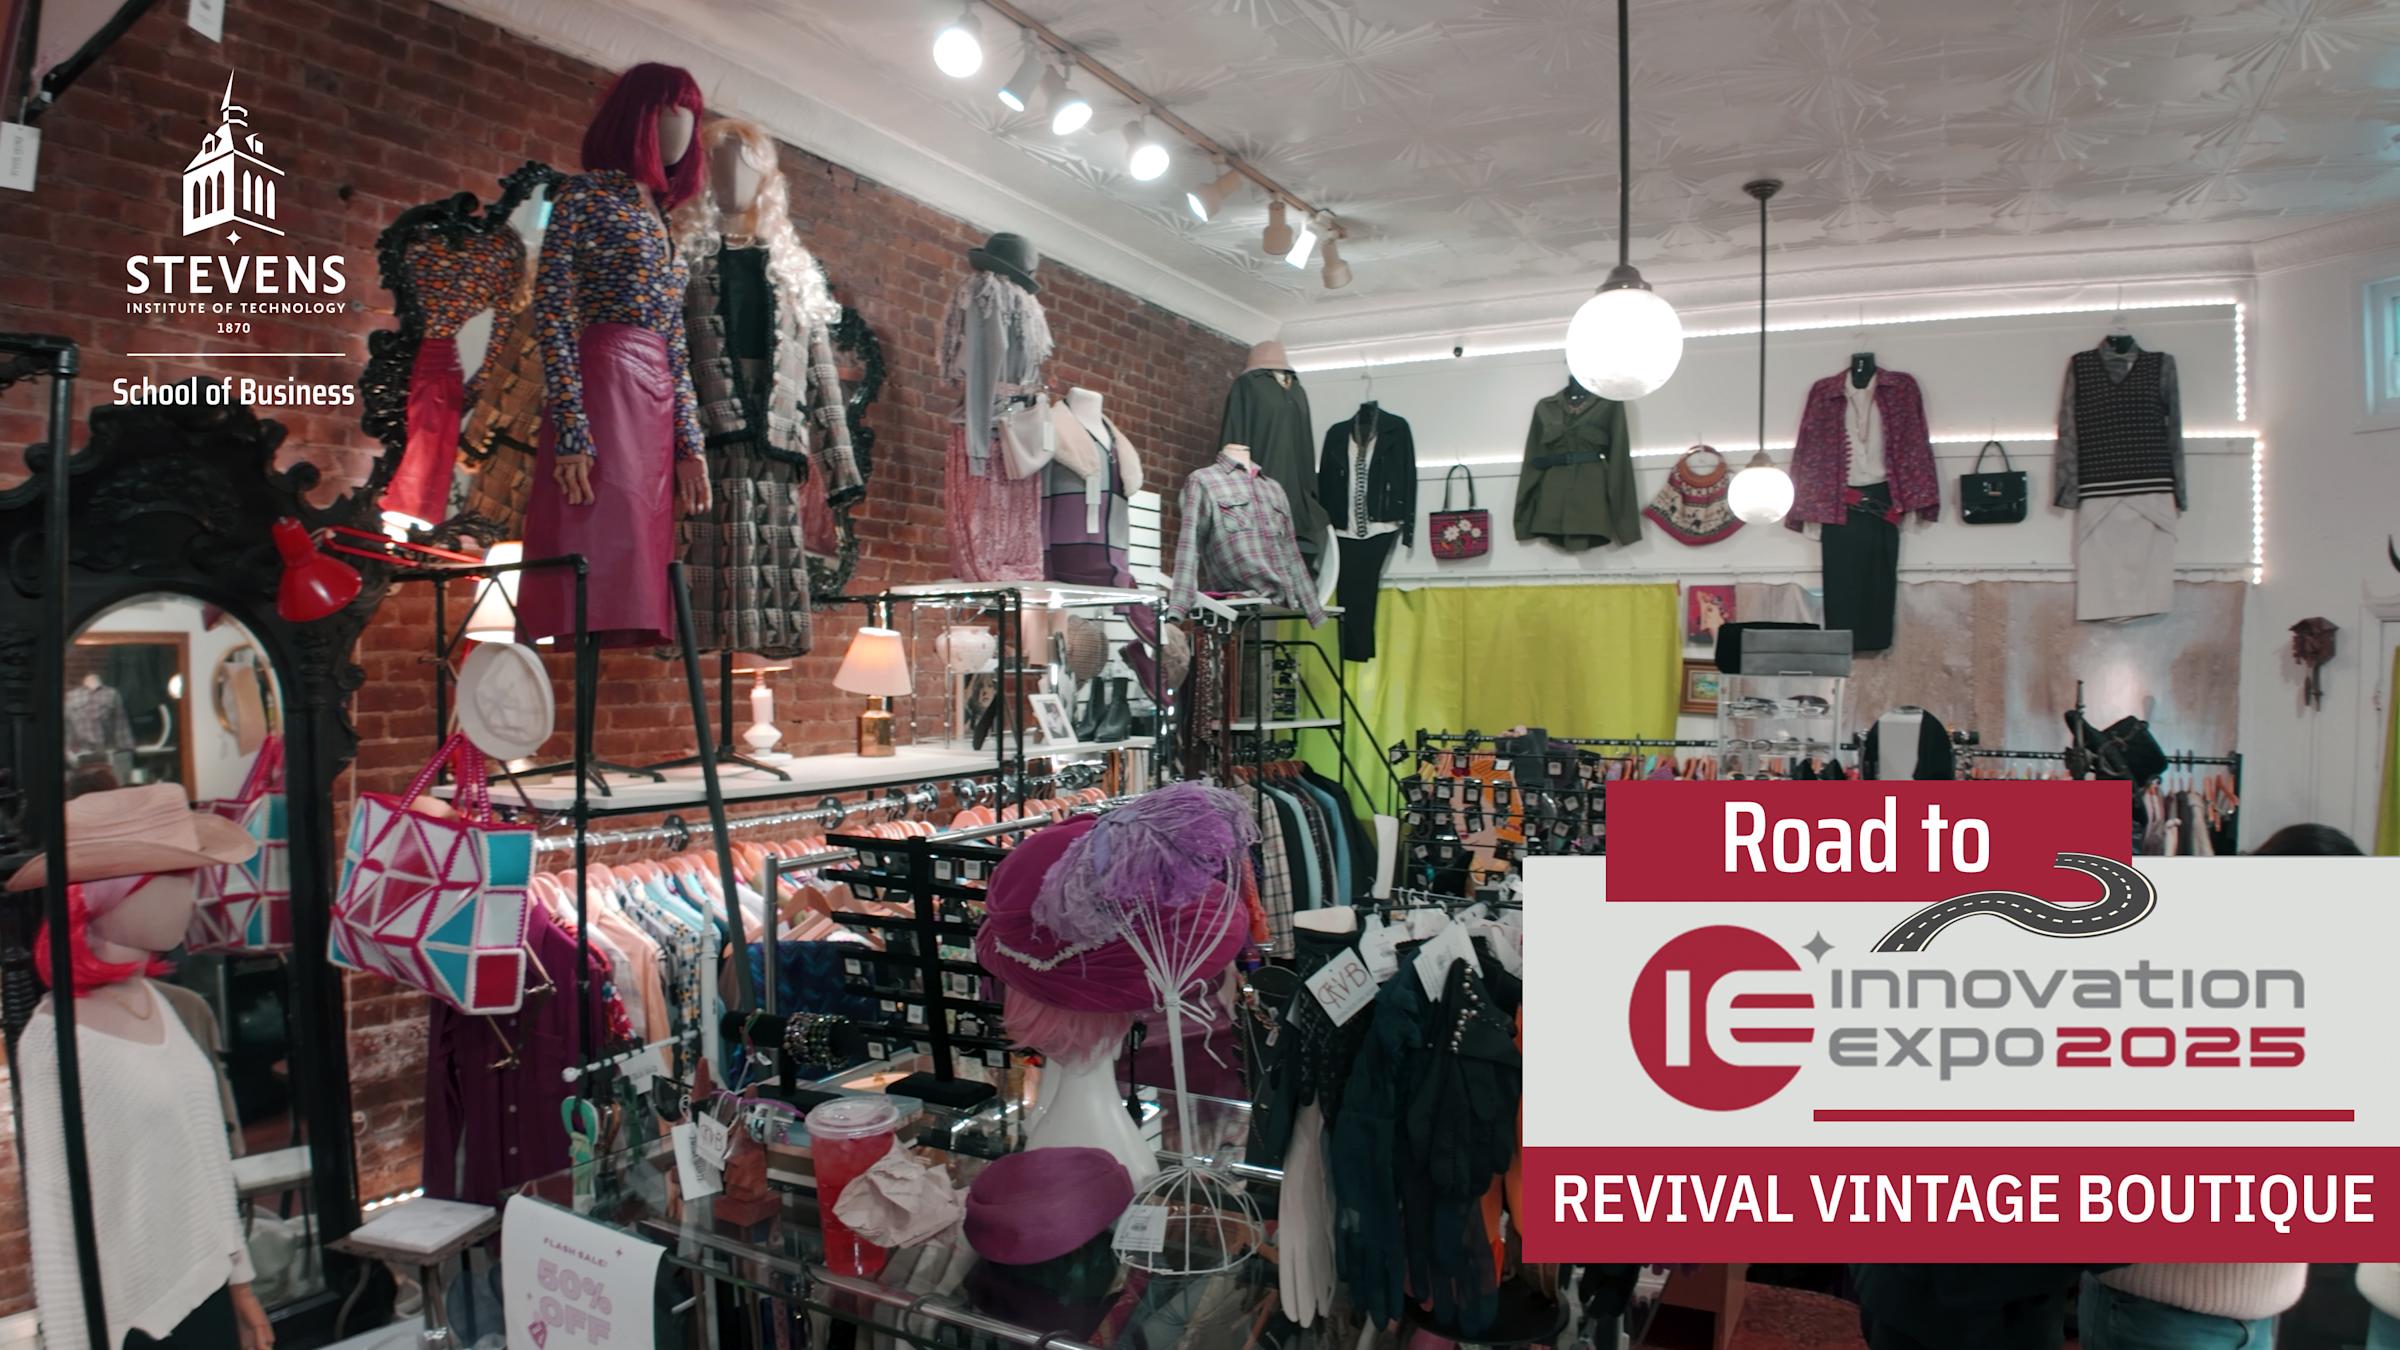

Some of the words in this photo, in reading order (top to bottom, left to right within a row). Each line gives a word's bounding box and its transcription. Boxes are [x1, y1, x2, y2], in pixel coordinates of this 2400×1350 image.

[543, 1237, 577, 1256] FLASH
[537, 1258, 613, 1316] 50%
[539, 1296, 611, 1346] OFF
